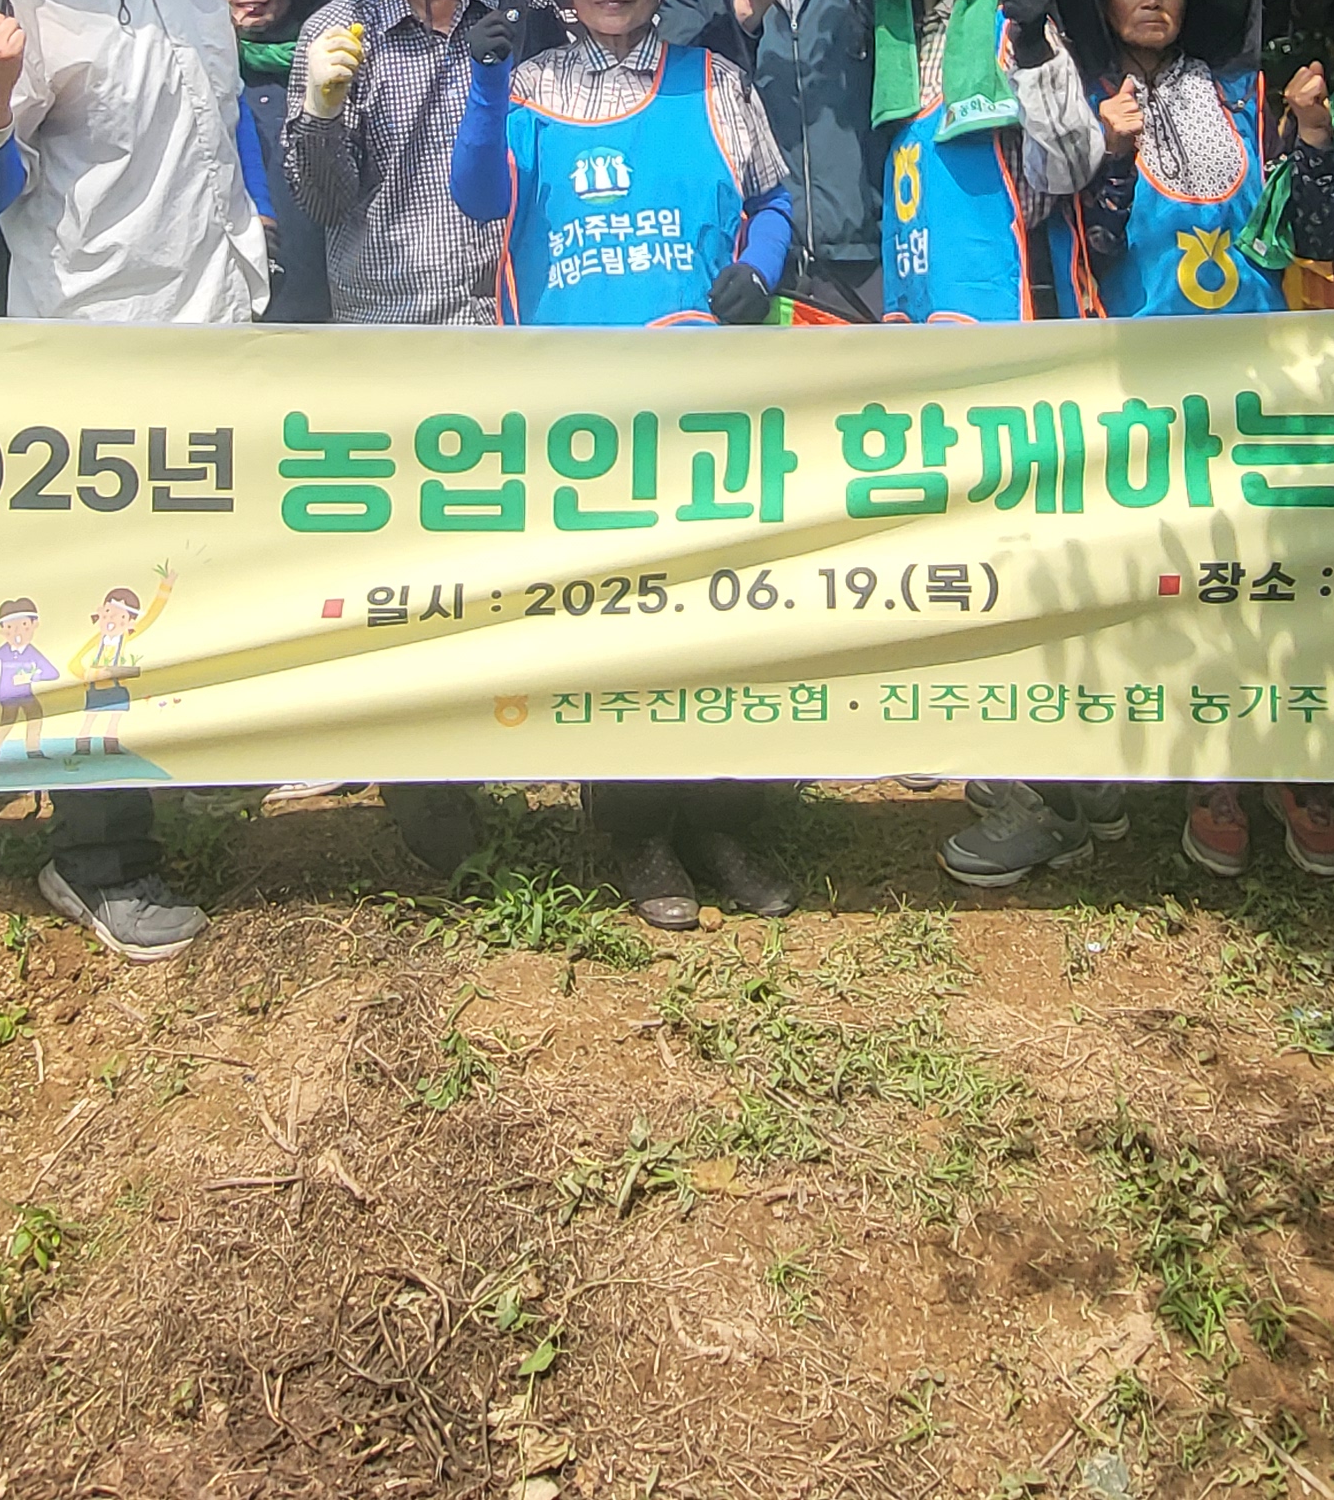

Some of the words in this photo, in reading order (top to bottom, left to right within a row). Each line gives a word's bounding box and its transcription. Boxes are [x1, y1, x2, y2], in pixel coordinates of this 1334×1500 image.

[278, 406, 799, 533] 농업인과
[367, 583, 464, 628] 일시
[524, 573, 684, 617] 2025.
[709, 568, 794, 610] 06.
[818, 562, 1000, 613] 19.(목)
[1197, 560, 1297, 604] 장소
[550, 682, 829, 725] 진주진양농협
[878, 683, 1165, 723] 진주진양농협
